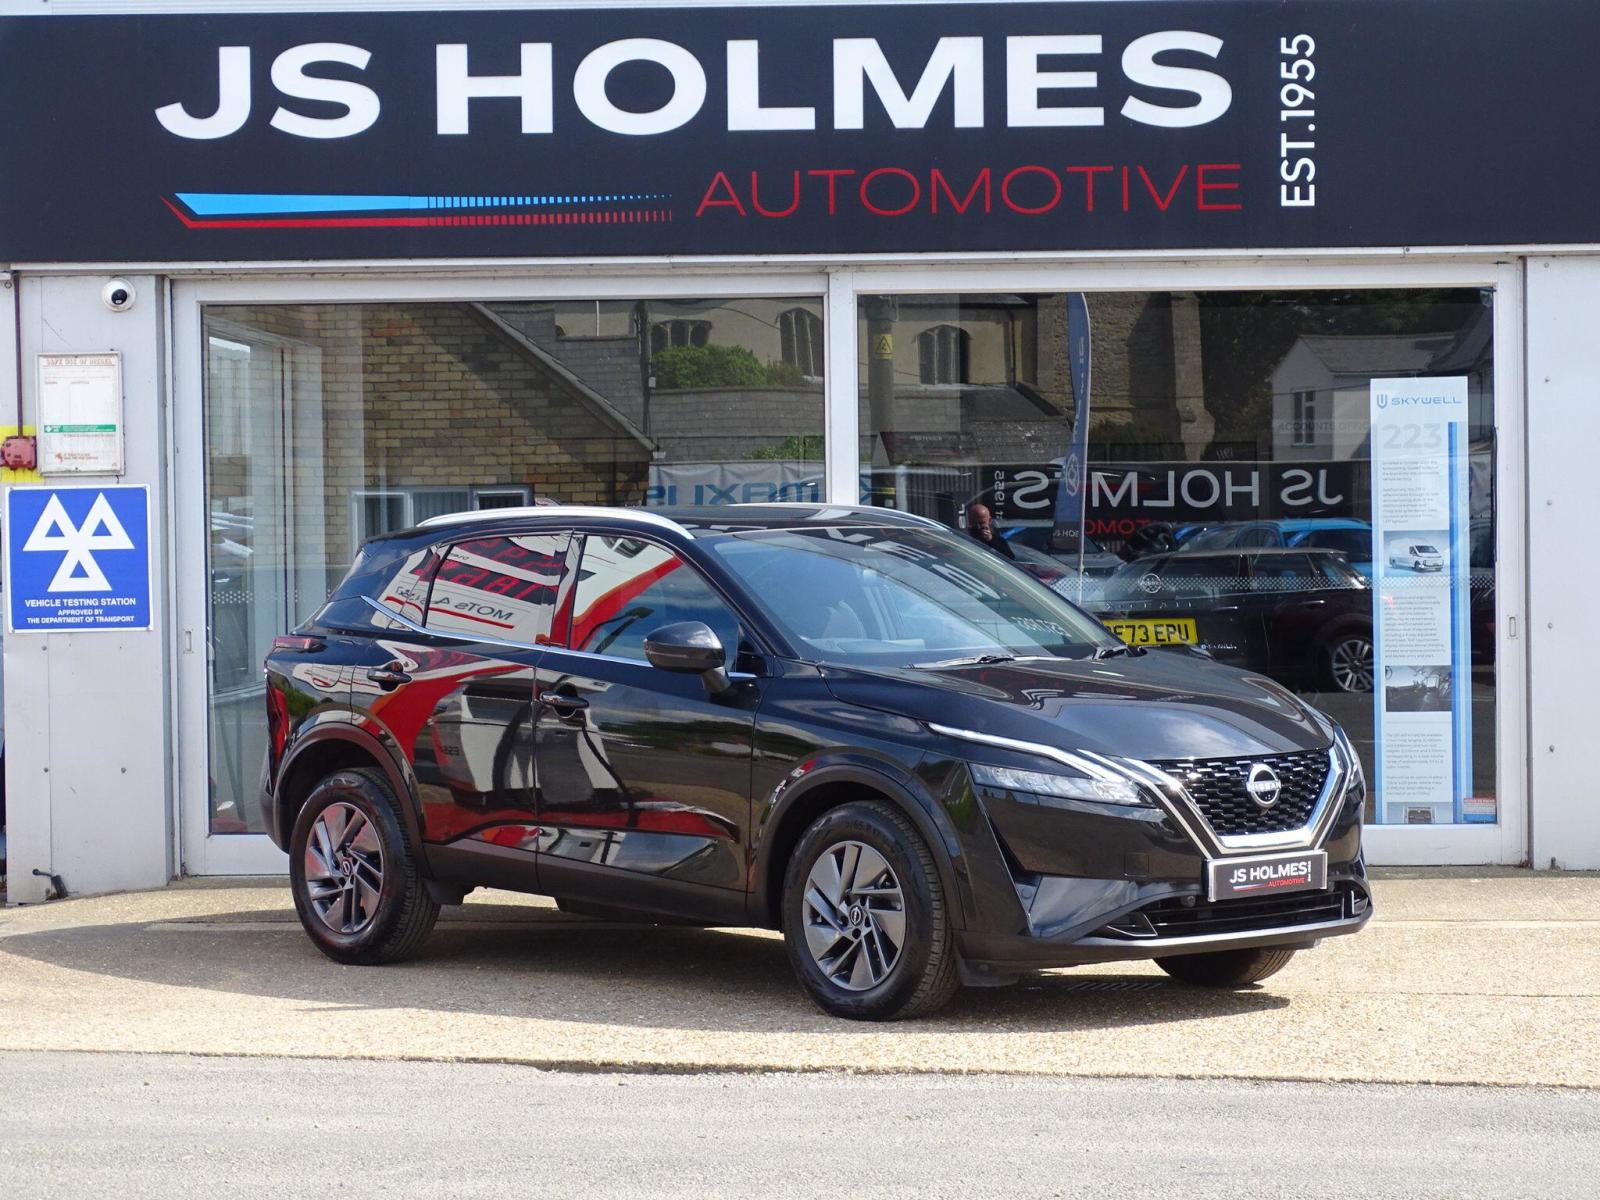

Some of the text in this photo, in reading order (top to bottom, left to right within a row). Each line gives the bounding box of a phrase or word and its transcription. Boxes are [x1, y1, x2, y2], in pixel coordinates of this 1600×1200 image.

[154, 30, 1233, 140] JS HOLMES
[1279, 33, 1316, 208] EST.1955
[695, 163, 1243, 219] AUTOMOTIVE
[1391, 395, 1463, 406] SKYWELL
[25, 597, 136, 608] VEHICLE TESTING STATION
[41, 616, 84, 624] DEPARTMENT
[96, 615, 135, 623] TRANSPORT
[1153, 623, 1189, 642] EPU
[1229, 868, 1247, 884] JS
[1249, 860, 1308, 881] HOLMES
[1267, 877, 1306, 888] AUTOMOTIVE
